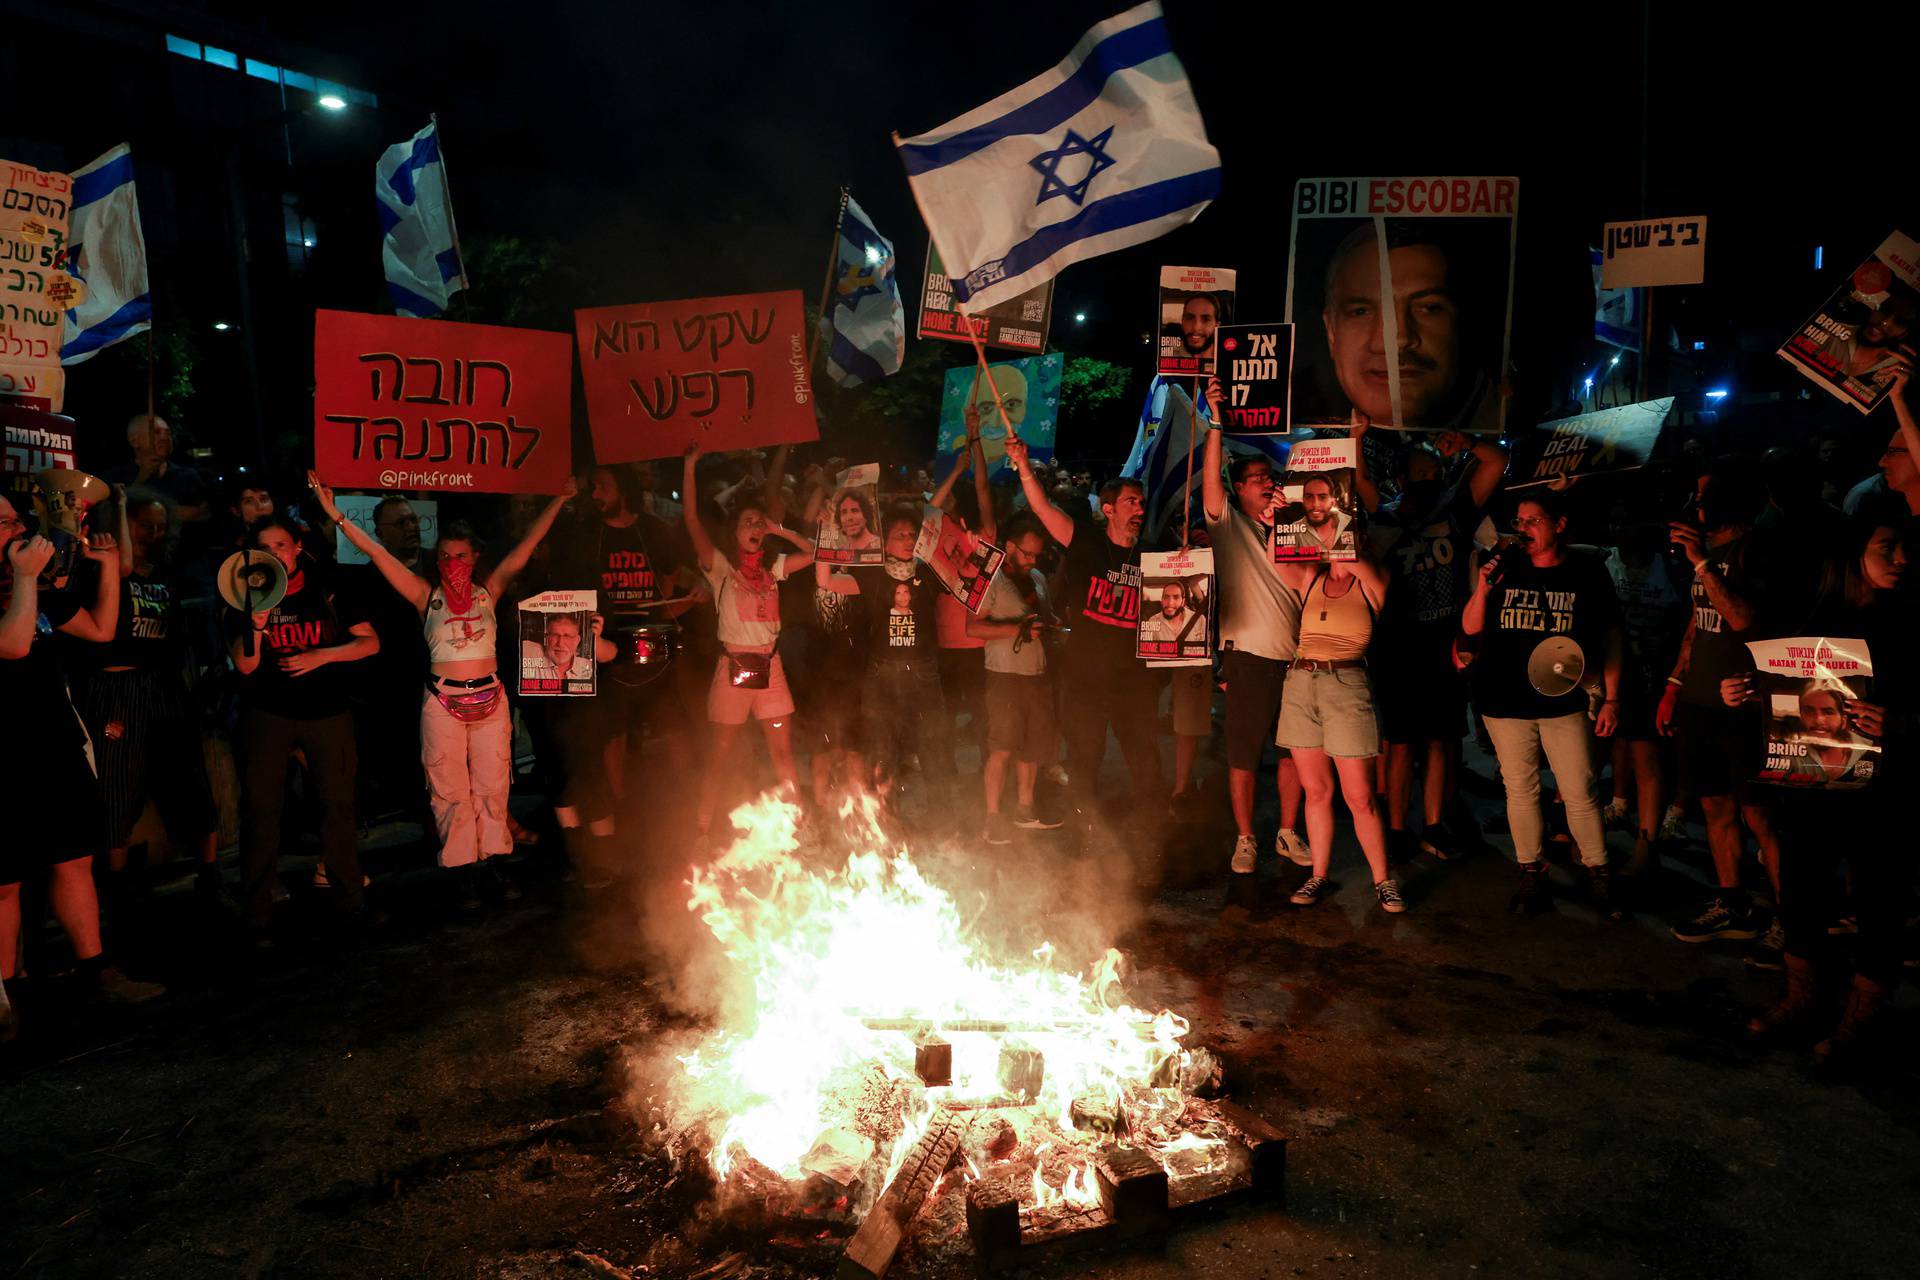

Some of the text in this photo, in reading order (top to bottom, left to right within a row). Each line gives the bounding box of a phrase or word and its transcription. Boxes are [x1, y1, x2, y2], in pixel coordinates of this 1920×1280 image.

[1297, 179, 1515, 214] BIBI ESCOBAR
[923, 311, 954, 331] HOME
[1815, 313, 1851, 341] BRING
[594, 308, 775, 362] שקט הוא
[1161, 336, 1181, 347] BRING
[1804, 324, 1829, 344] HIM
[1161, 347, 1174, 356] HIM
[1248, 333, 1277, 357] אל
[1160, 357, 1178, 368] HOME
[1232, 359, 1278, 381] תתנו
[360, 352, 512, 406] חובה
[1231, 383, 1250, 406] לו
[1224, 406, 1281, 428] להקריב
[5, 426, 72, 450] המלחמה
[325, 414, 542, 469] להתנגד
[1543, 435, 1590, 457] DEAL
[5, 447, 74, 473] רעה
[1532, 453, 1585, 478] NOW
[1276, 524, 1307, 534] BRING
[1276, 535, 1296, 545] HIM
[1276, 546, 1296, 555] HOME
[600, 571, 654, 588] חטופים
[1087, 576, 1140, 619] עכשיו
[1503, 588, 1540, 608] בבית
[889, 615, 915, 625] DEAL
[1141, 622, 1161, 631] BRING
[1500, 608, 1545, 631] בעזה!
[268, 620, 321, 648] NOW
[889, 637, 915, 647] NOW!
[1140, 632, 1153, 641] HIM
[1140, 642, 1157, 652] HOME
[522, 657, 544, 668] BRING
[1769, 659, 1796, 668] MATAN
[522, 679, 540, 689] HOME
[1768, 743, 1807, 757] BRING
[1766, 758, 1790, 770] HIM
